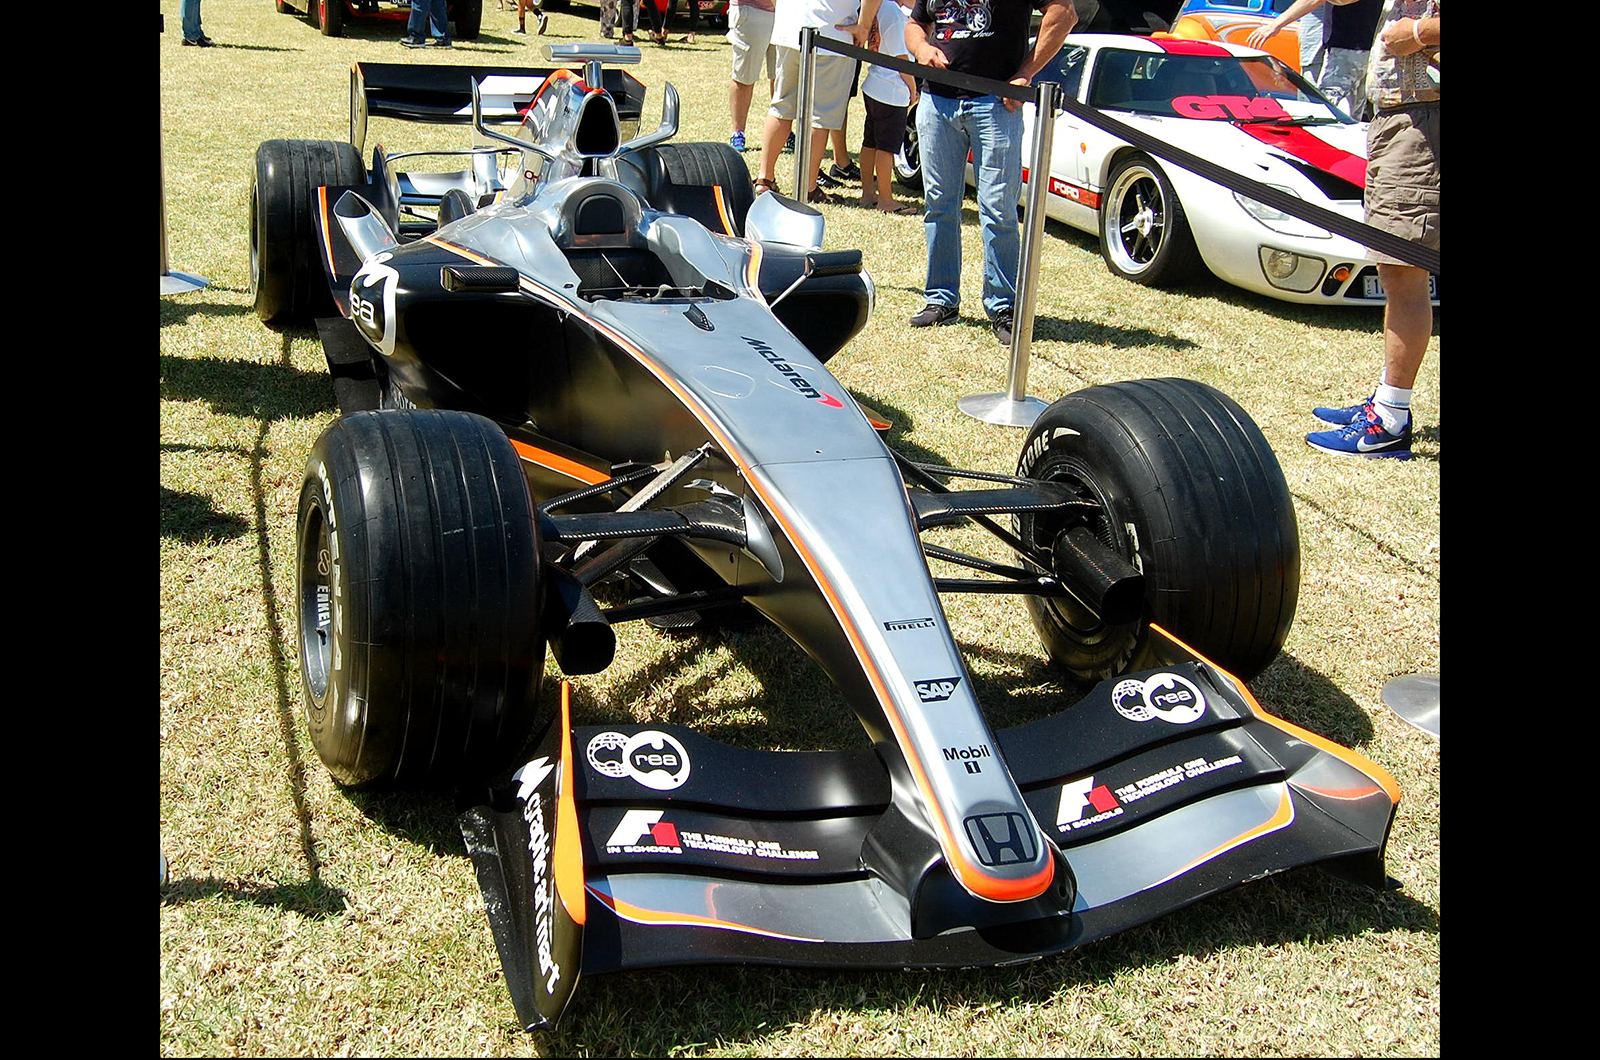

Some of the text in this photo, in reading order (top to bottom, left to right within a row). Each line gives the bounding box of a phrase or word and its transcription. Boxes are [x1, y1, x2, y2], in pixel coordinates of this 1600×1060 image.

[1054, 181, 1079, 199] FORD
[317, 584, 331, 627] ENKEI
[883, 618, 936, 631] PIRELLI
[916, 681, 955, 699] SAP
[1154, 690, 1193, 706] rea
[635, 753, 678, 766] rea
[942, 745, 991, 761] Mobil
[966, 761, 979, 773] 1
[1115, 757, 1207, 797] THE FORMULA ONE
[1120, 755, 1243, 804] TECHNOLOGY CHALLENGE
[1058, 807, 1124, 832] IN SCHOOLS
[681, 831, 781, 850] THE FORMULA ONE
[624, 846, 683, 854] SCHOOLS
[684, 840, 819, 860] TECHNOLOGY CHALLENGE
[536, 921, 560, 994] mart
